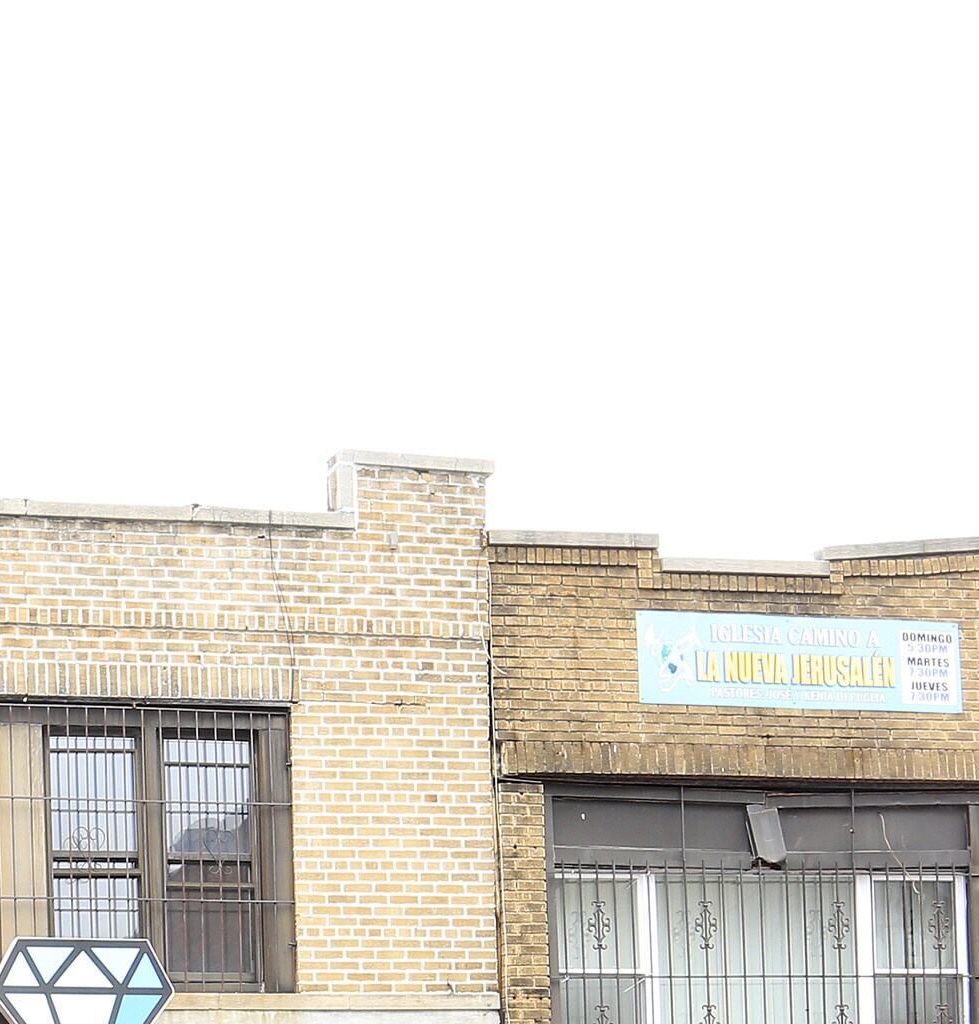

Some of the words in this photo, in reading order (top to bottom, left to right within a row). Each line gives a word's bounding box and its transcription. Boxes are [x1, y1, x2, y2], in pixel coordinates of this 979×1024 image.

[710, 623, 783, 645] IGLESIA
[788, 626, 862, 648] CAMINO
[866, 629, 881, 648] A
[902, 632, 953, 644] DOMINGO
[907, 657, 950, 668] MARTES
[695, 650, 721, 683] LA
[723, 651, 788, 685] NUEVA
[790, 651, 897, 689] JERUSALÉN
[911, 681, 949, 691] JUEVES
